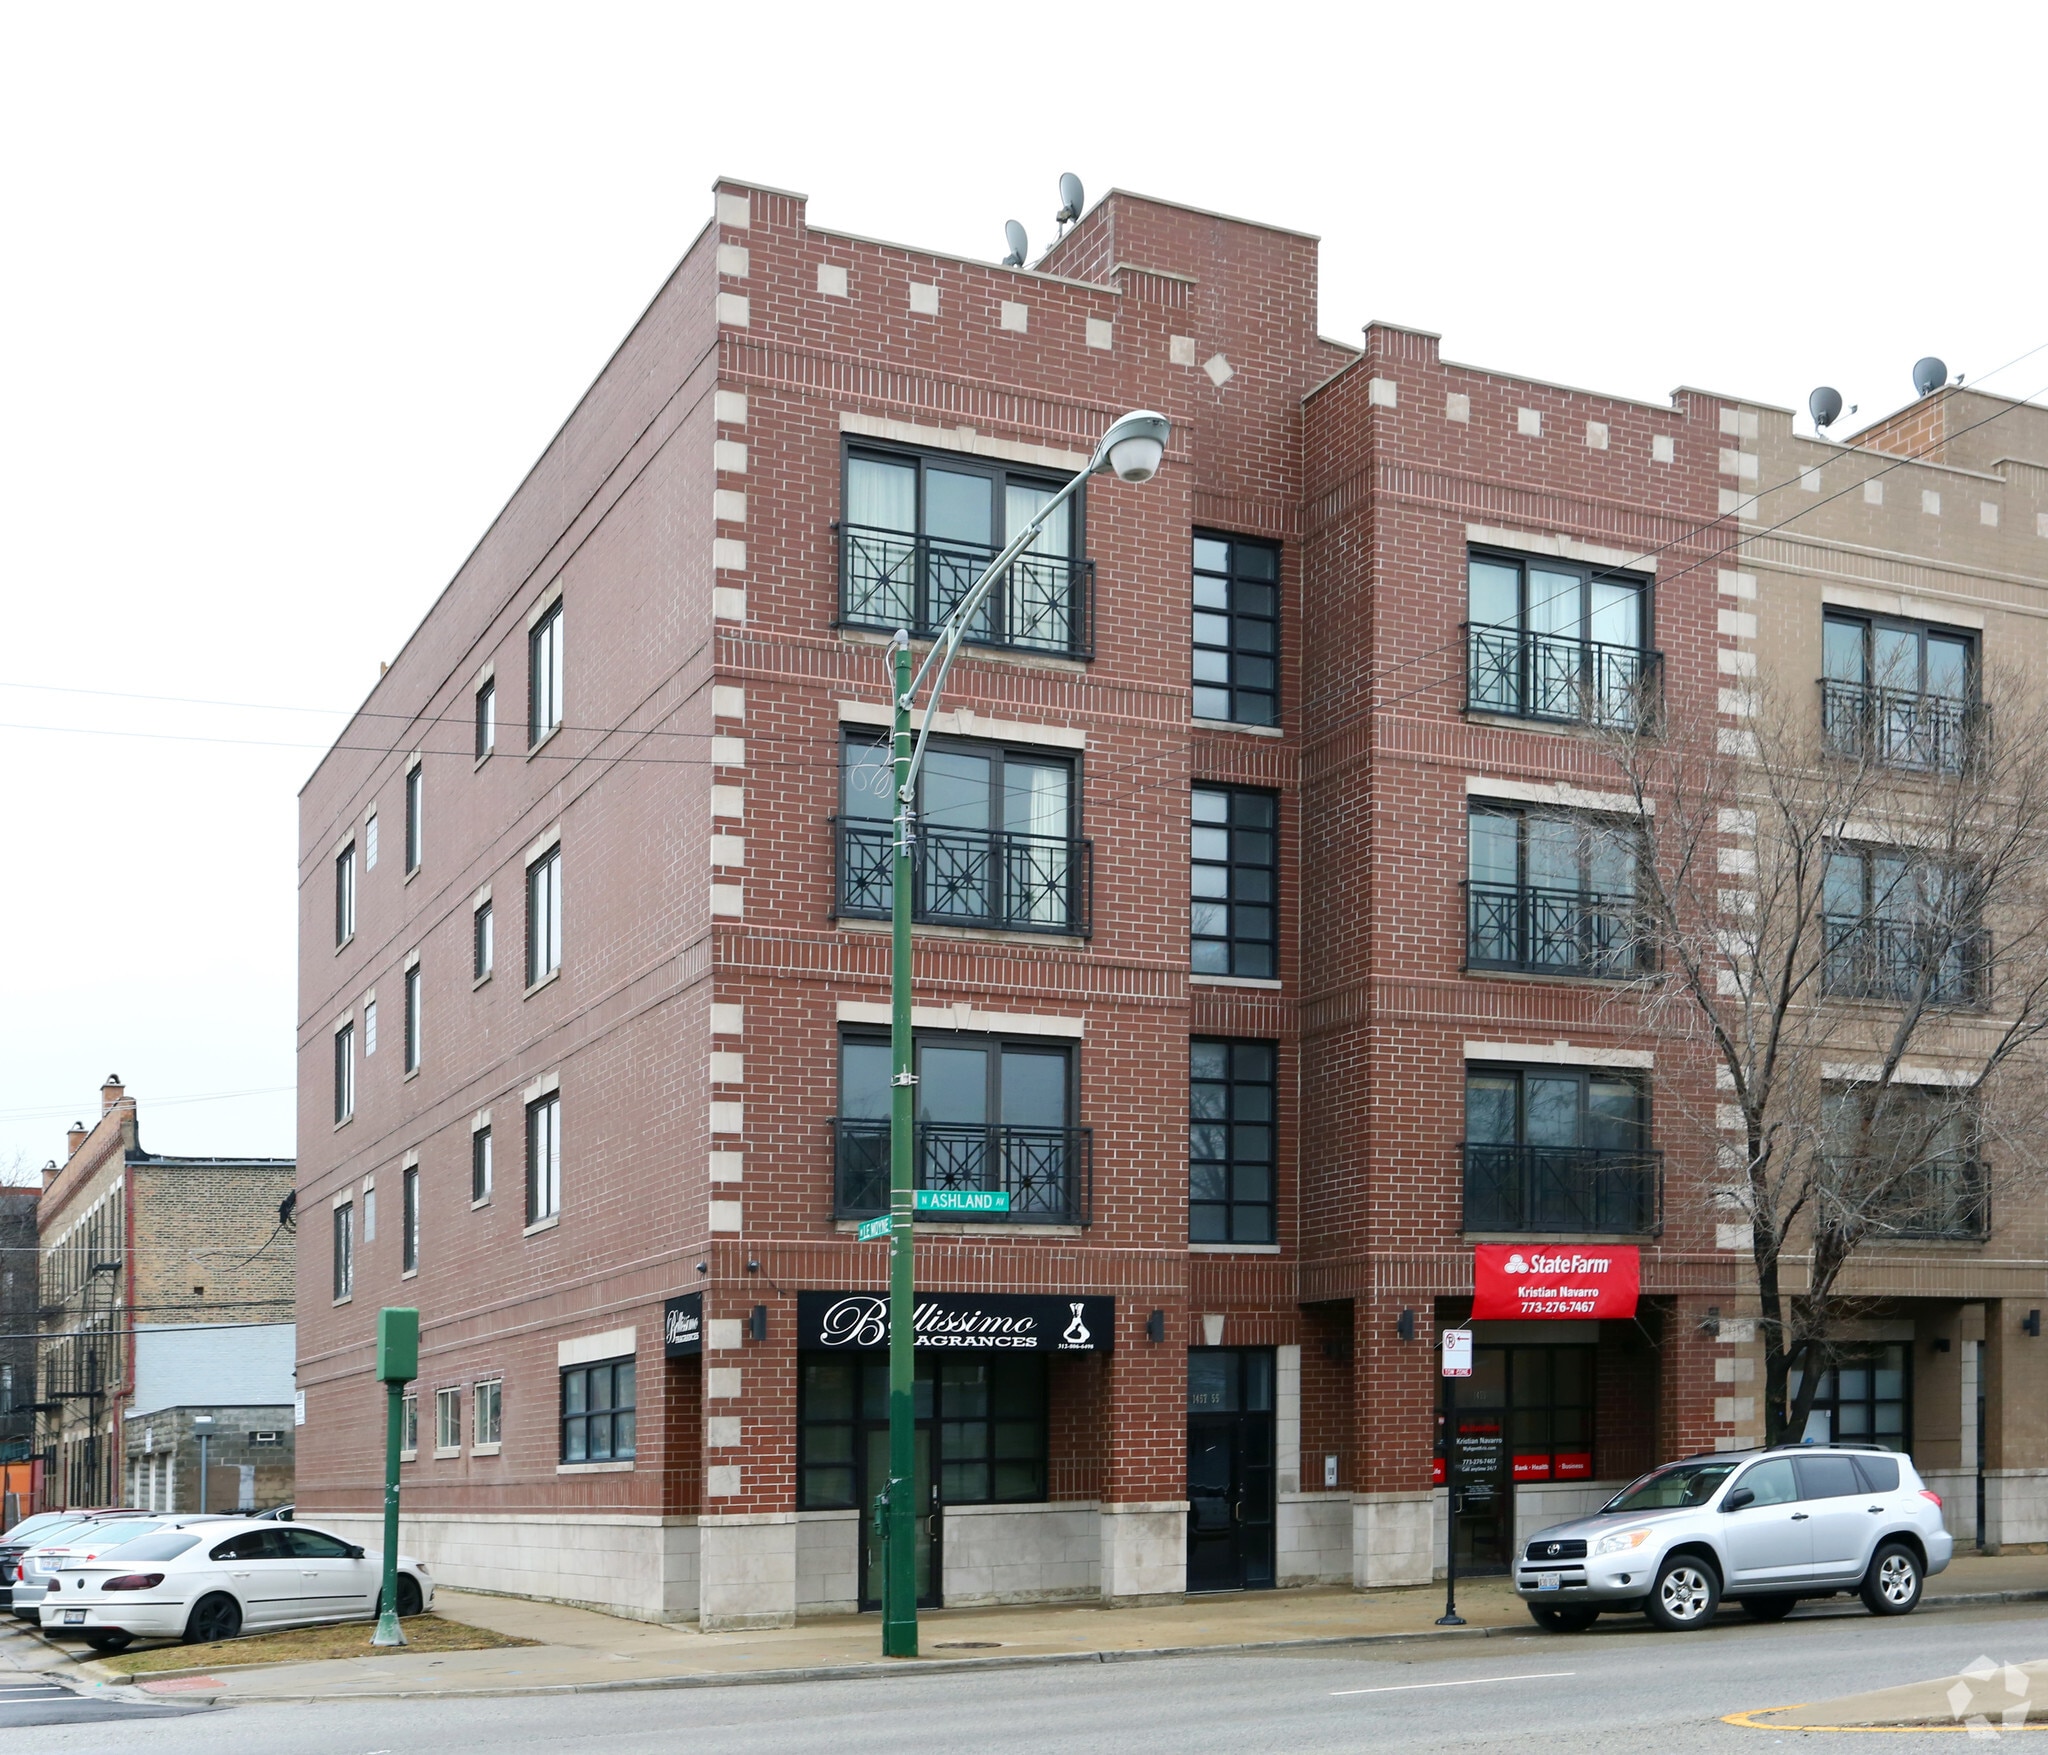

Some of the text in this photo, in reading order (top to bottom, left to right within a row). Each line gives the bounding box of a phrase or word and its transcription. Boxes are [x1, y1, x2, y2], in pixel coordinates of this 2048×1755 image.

[921, 1194, 1005, 1208] N ASHLAND AV
[864, 1223, 870, 1238] LE
[871, 1217, 889, 1236] MOYNE
[1518, 1286, 1599, 1298] Kristian Navarro
[1521, 1301, 1595, 1313] 773-276-7467
[820, 1296, 1038, 1346] Bllissimo
[887, 1335, 1037, 1347] AGRANCES
[1456, 1437, 1479, 1445] Kristian
